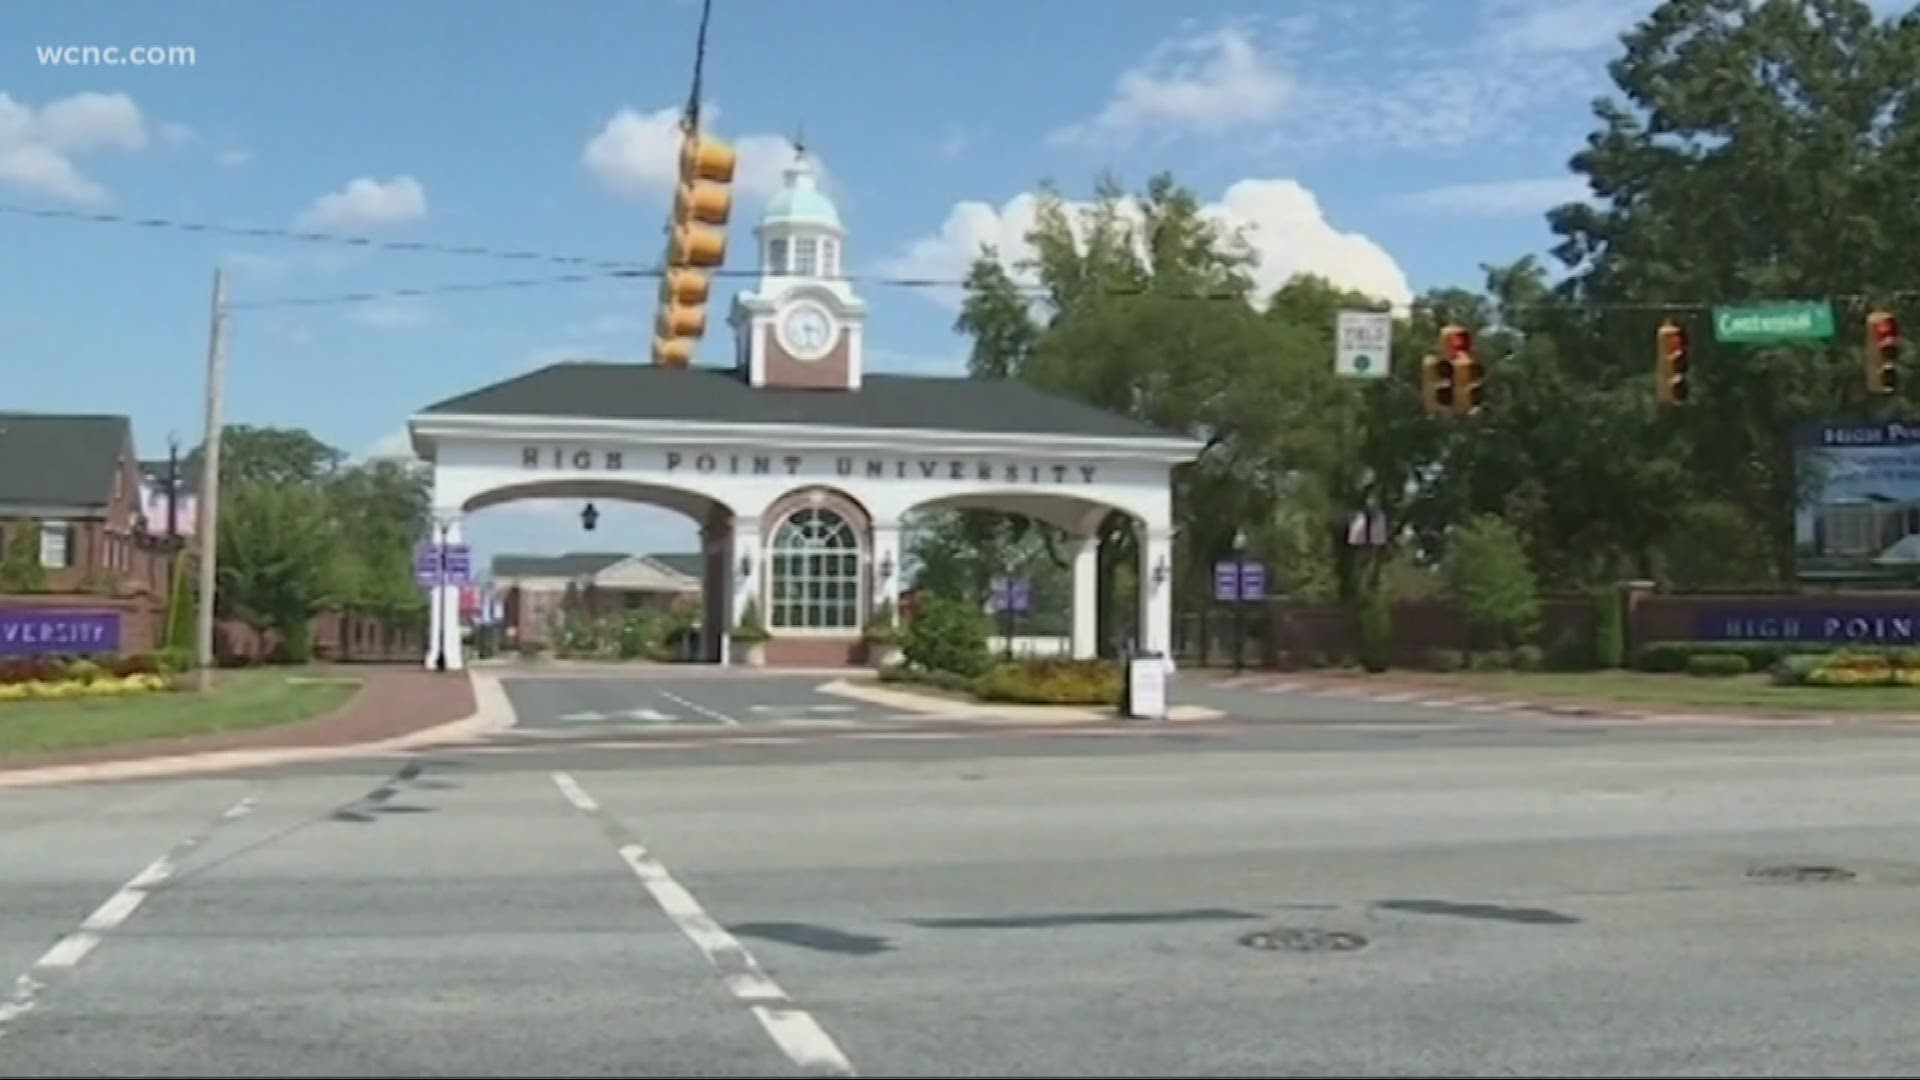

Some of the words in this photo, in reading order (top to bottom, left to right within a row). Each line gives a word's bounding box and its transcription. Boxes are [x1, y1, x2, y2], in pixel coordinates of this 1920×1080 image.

[1719, 308, 1811, 335] Centennial
[521, 447, 623, 470] HIGH
[665, 451, 803, 475] POINT
[836, 456, 1097, 484] UNIVERSITY
[1726, 617, 1799, 637] HIGH
[1824, 617, 1912, 638] POIN
